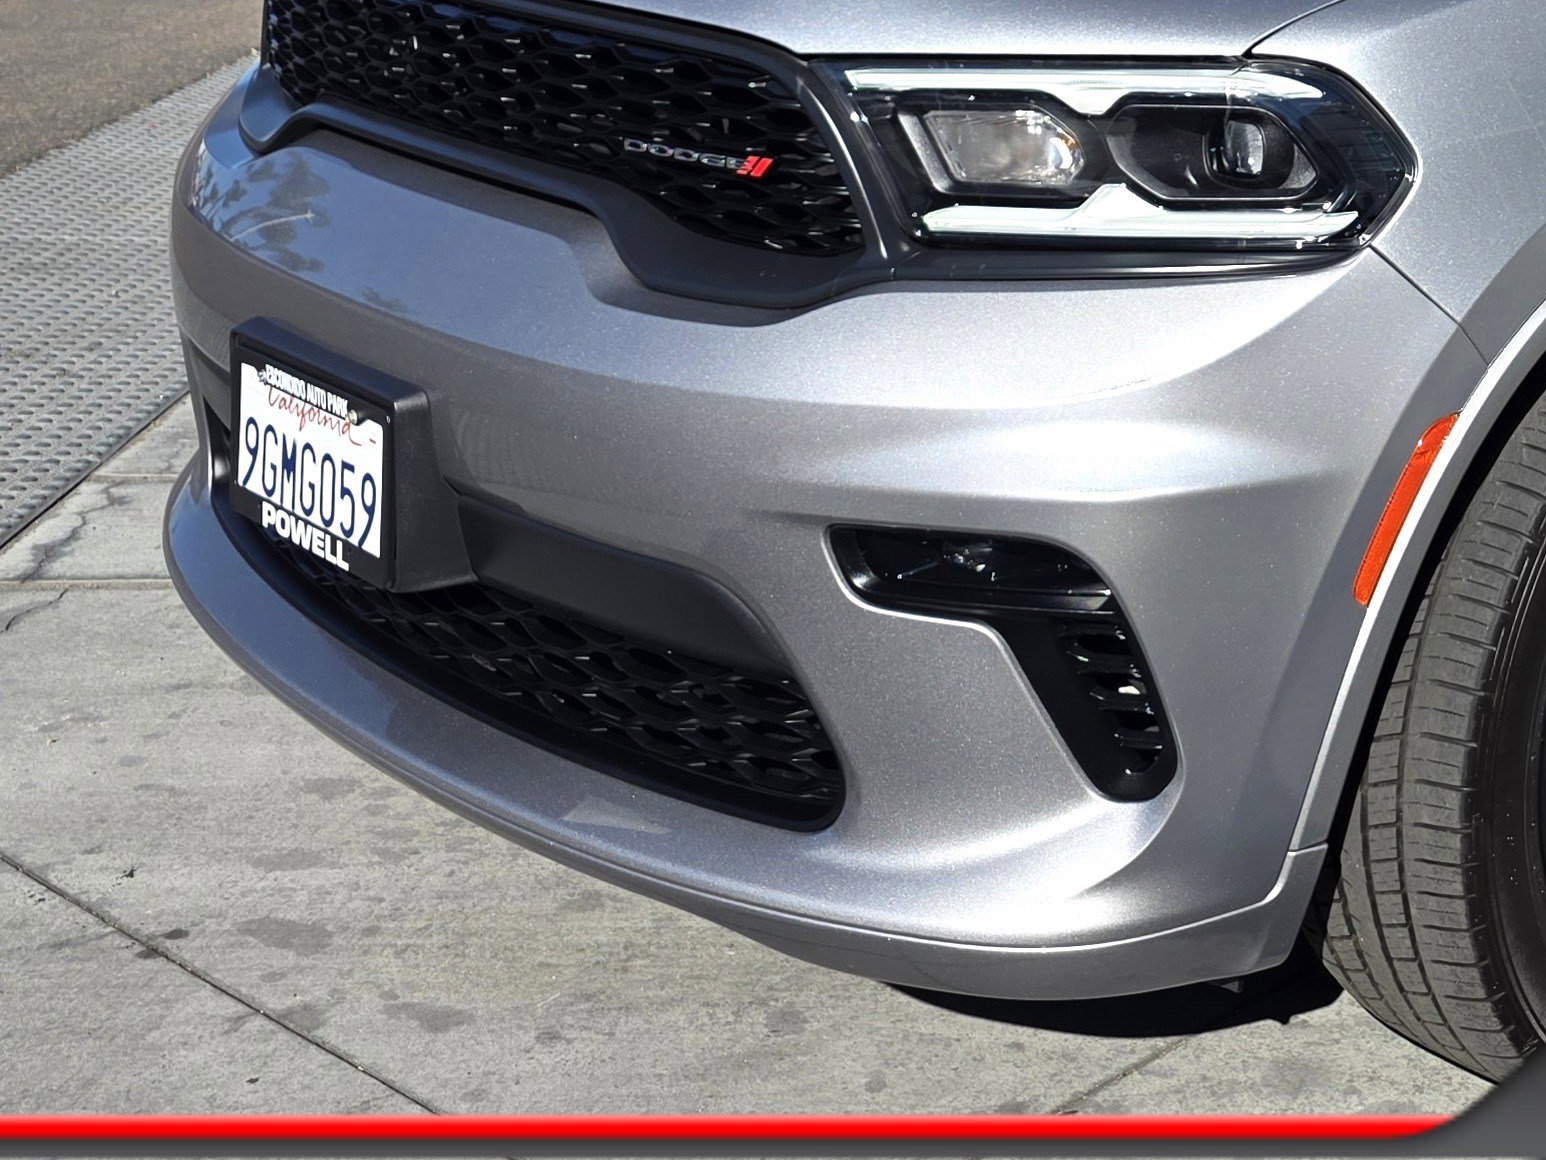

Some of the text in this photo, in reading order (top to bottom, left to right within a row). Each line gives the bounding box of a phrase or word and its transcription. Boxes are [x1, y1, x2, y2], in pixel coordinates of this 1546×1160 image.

[624, 138, 749, 170] DODGE
[265, 363, 349, 418] ESCONDIDO AUTO PARK
[242, 417, 377, 547] 9GMG059
[261, 500, 350, 572] POWELL
